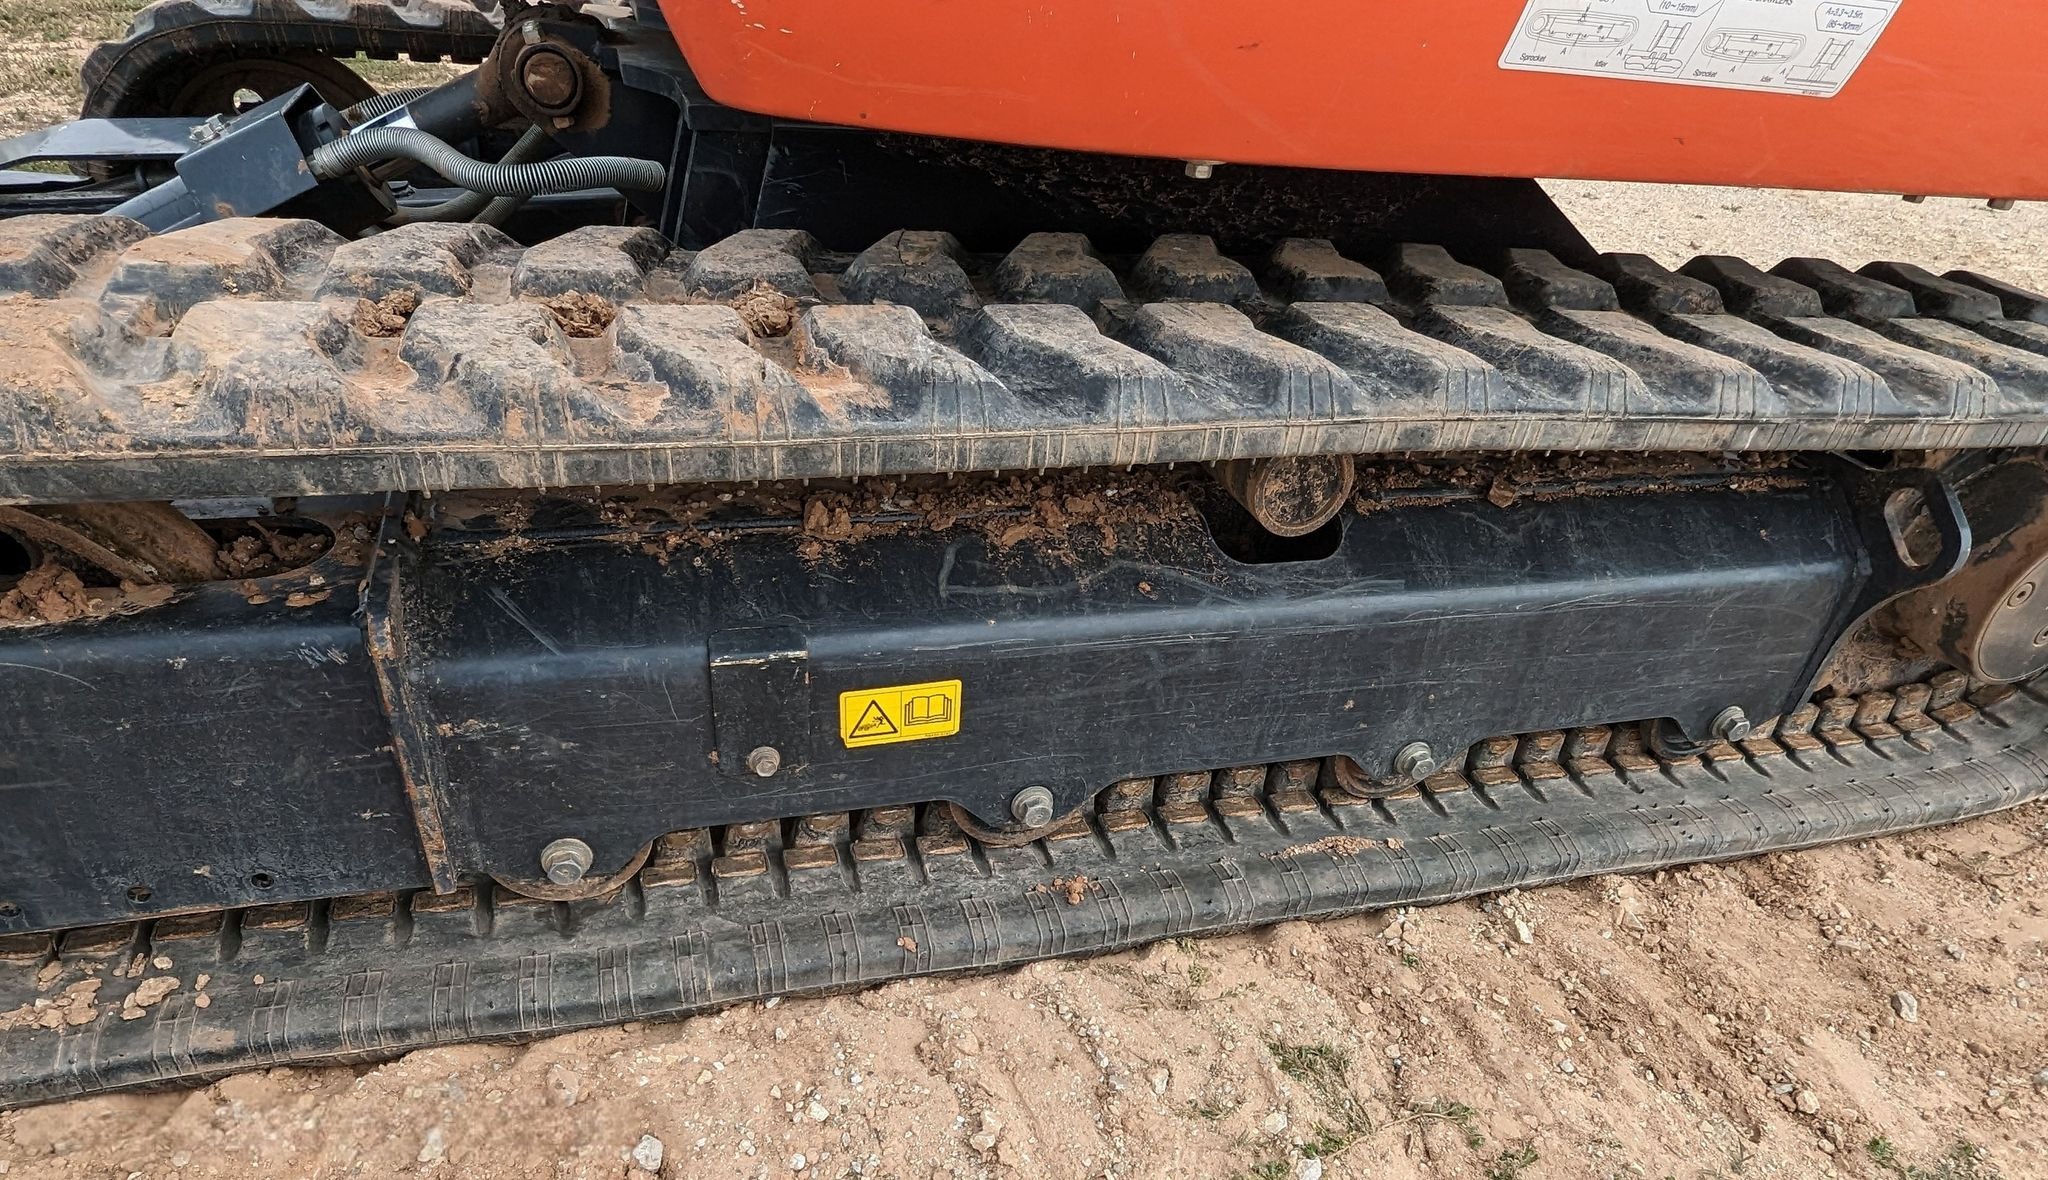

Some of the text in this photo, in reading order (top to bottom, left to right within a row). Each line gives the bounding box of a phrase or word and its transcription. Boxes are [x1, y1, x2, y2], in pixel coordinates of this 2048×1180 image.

[1560, 47, 1567, 55] A
[1616, 48, 1624, 56] A
[1519, 53, 1547, 62] Sprocket
[1594, 59, 1608, 68] Idler
[1729, 65, 1736, 73] A
[1779, 67, 1787, 75] A
